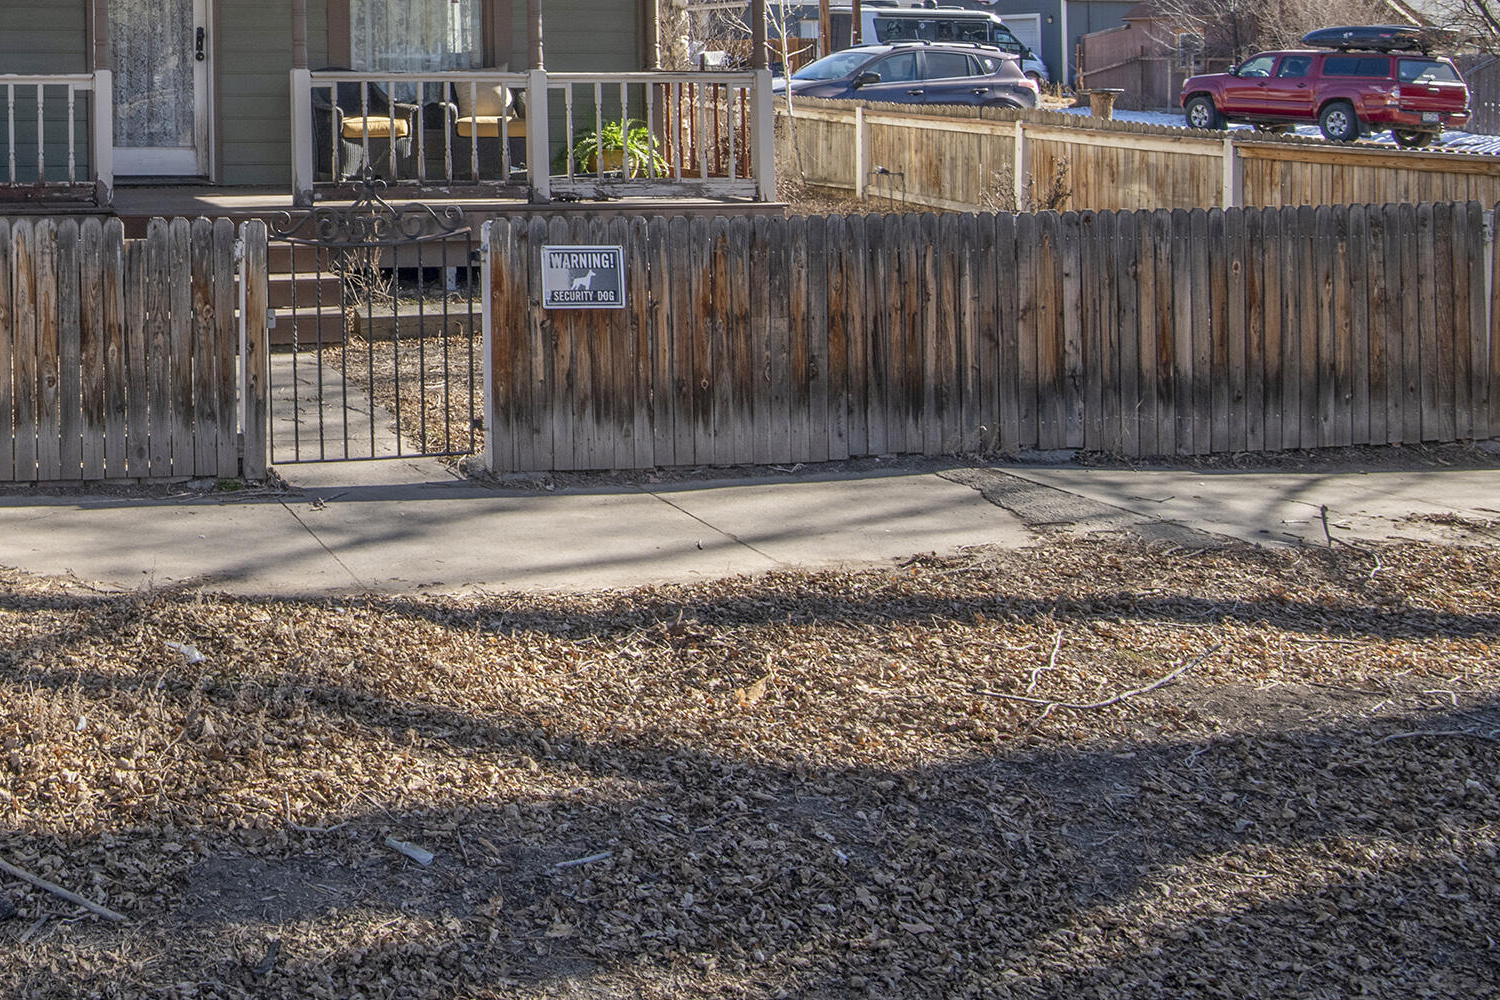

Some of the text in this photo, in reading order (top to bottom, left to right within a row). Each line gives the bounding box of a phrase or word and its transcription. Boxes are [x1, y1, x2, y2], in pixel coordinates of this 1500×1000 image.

[550, 253, 614, 268] WARNING!
[553, 291, 614, 301] SECURITY DOG
